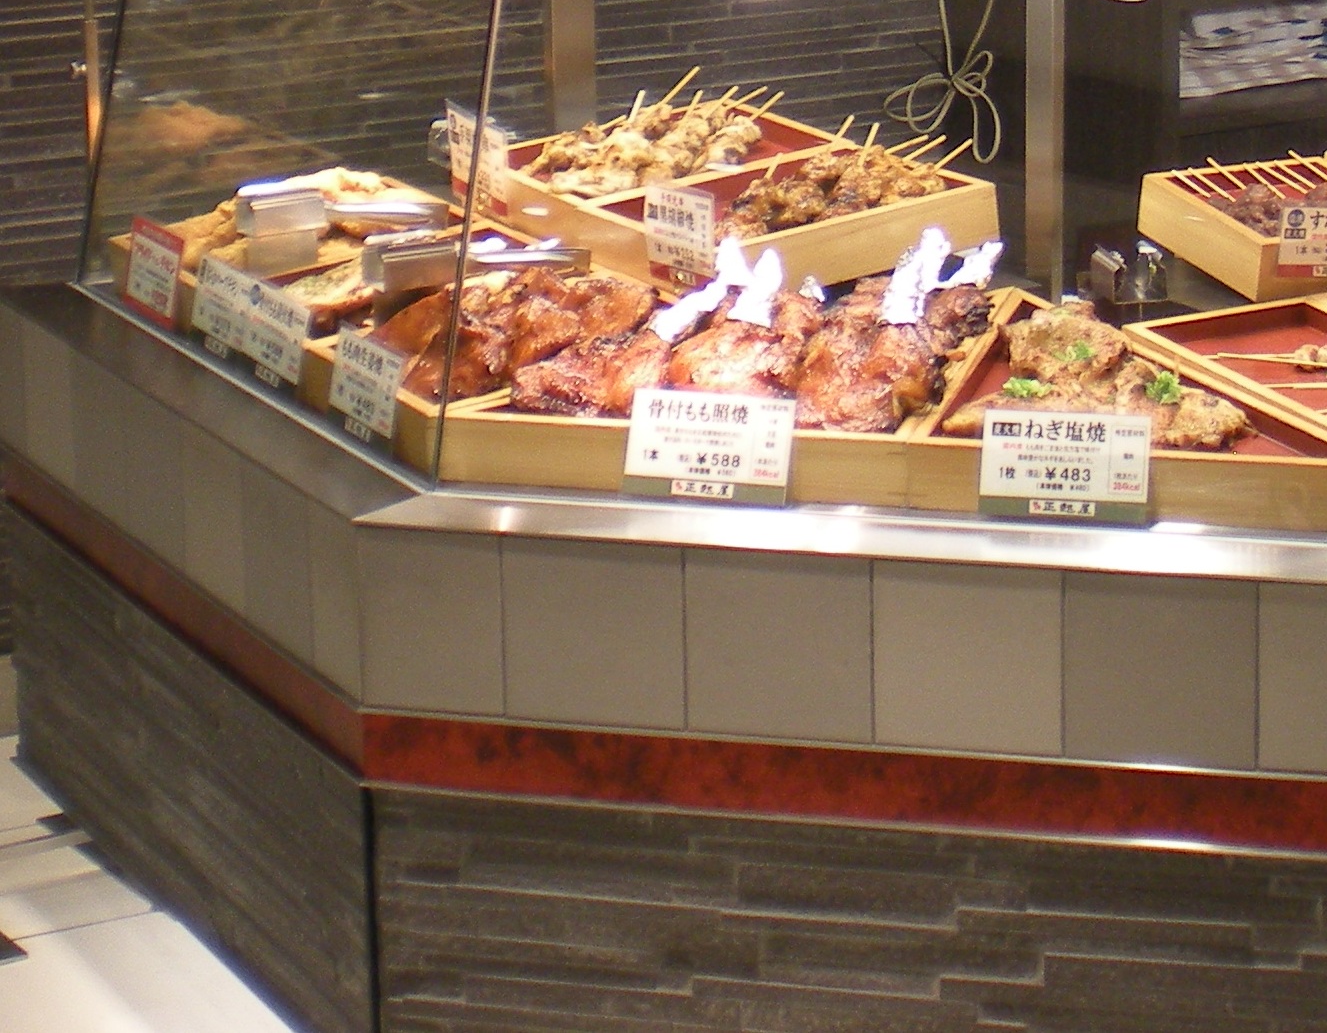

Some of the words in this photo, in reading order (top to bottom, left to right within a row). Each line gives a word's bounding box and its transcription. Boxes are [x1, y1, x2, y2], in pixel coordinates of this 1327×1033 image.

[648, 398, 749, 425] 骨付もも照焼
[1025, 419, 1107, 443] ねぎ塩焼
[697, 451, 741, 468] ¥588
[999, 467, 1016, 479] 1枚
[1045, 467, 1091, 482] ¥483
[1042, 501, 1092, 515] 正起屋
